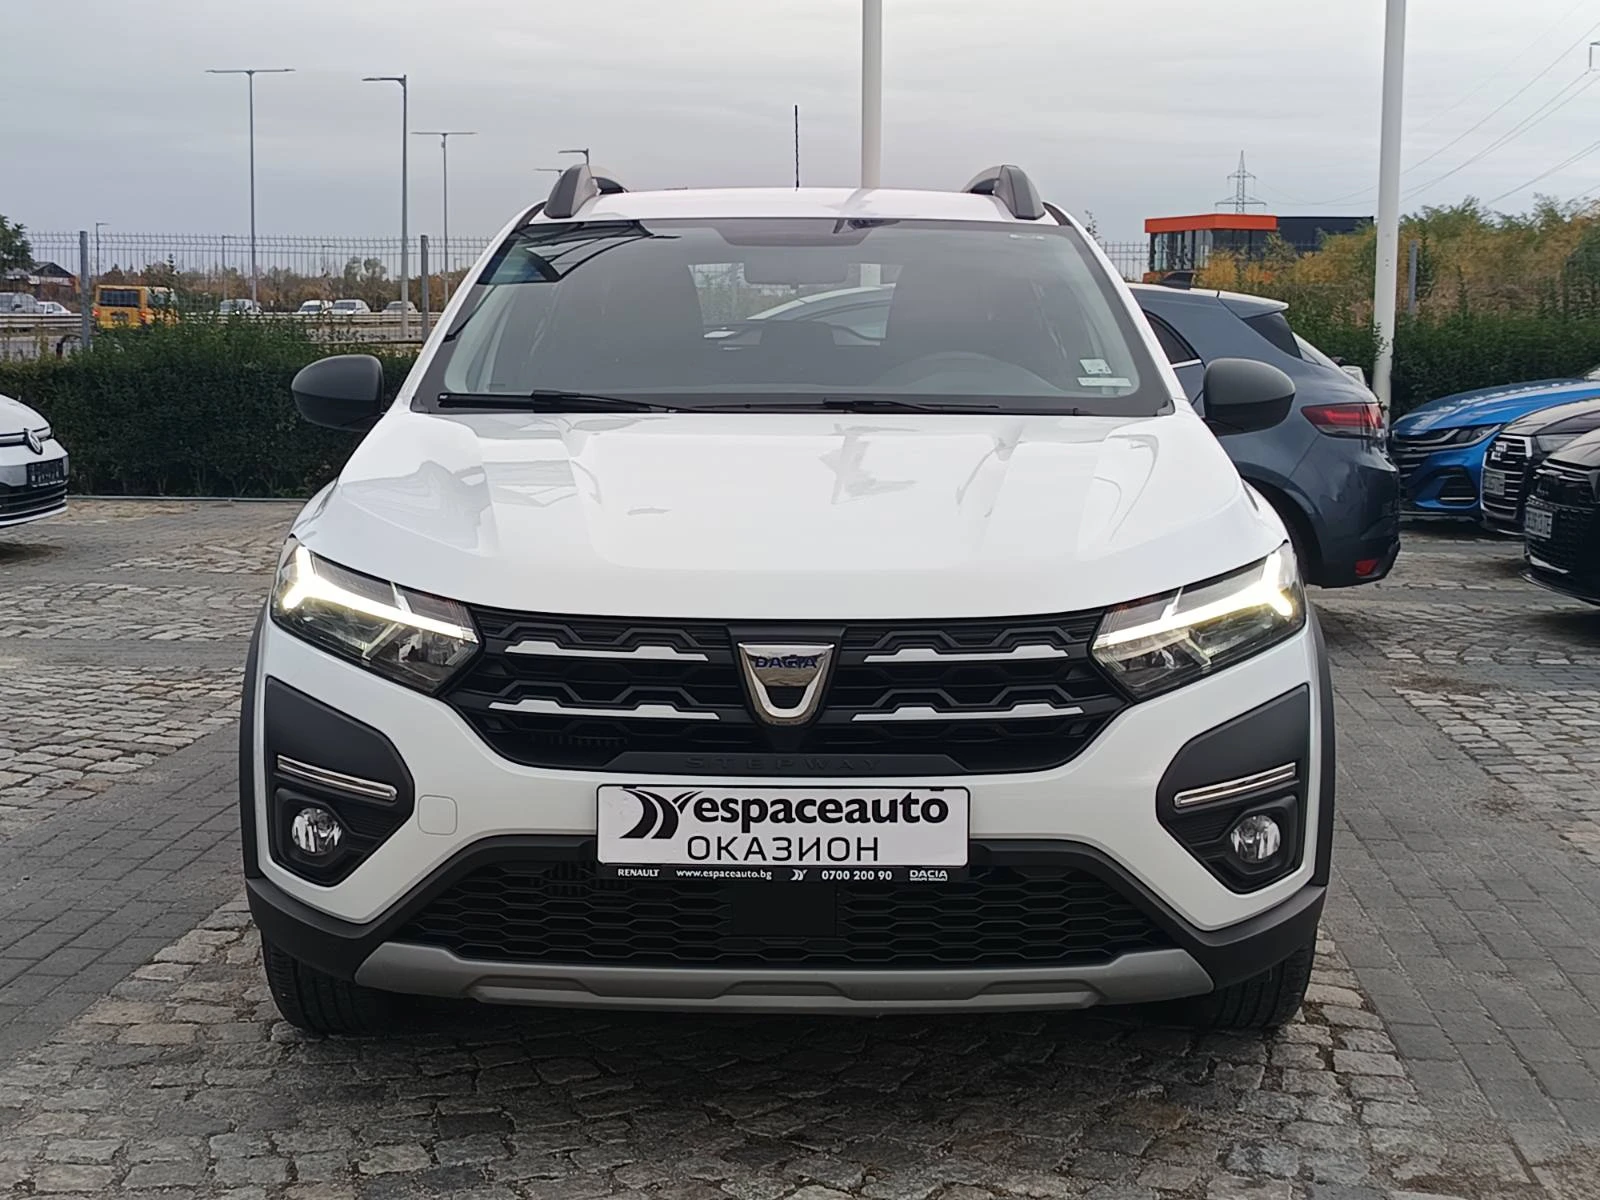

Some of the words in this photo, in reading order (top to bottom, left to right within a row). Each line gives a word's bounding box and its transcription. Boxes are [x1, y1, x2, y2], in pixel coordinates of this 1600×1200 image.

[754, 655, 817, 668] DACIA
[684, 756, 880, 771] STEPWAY
[692, 791, 949, 833] espaceauto
[686, 836, 879, 862] ОКАЗИОН
[617, 868, 660, 878] RENAULT
[676, 869, 772, 880] www.espaceauto.bg
[821, 870, 850, 880] 0700
[853, 870, 875, 880] 200
[877, 870, 893, 880] 90
[909, 869, 948, 879] DACIA
